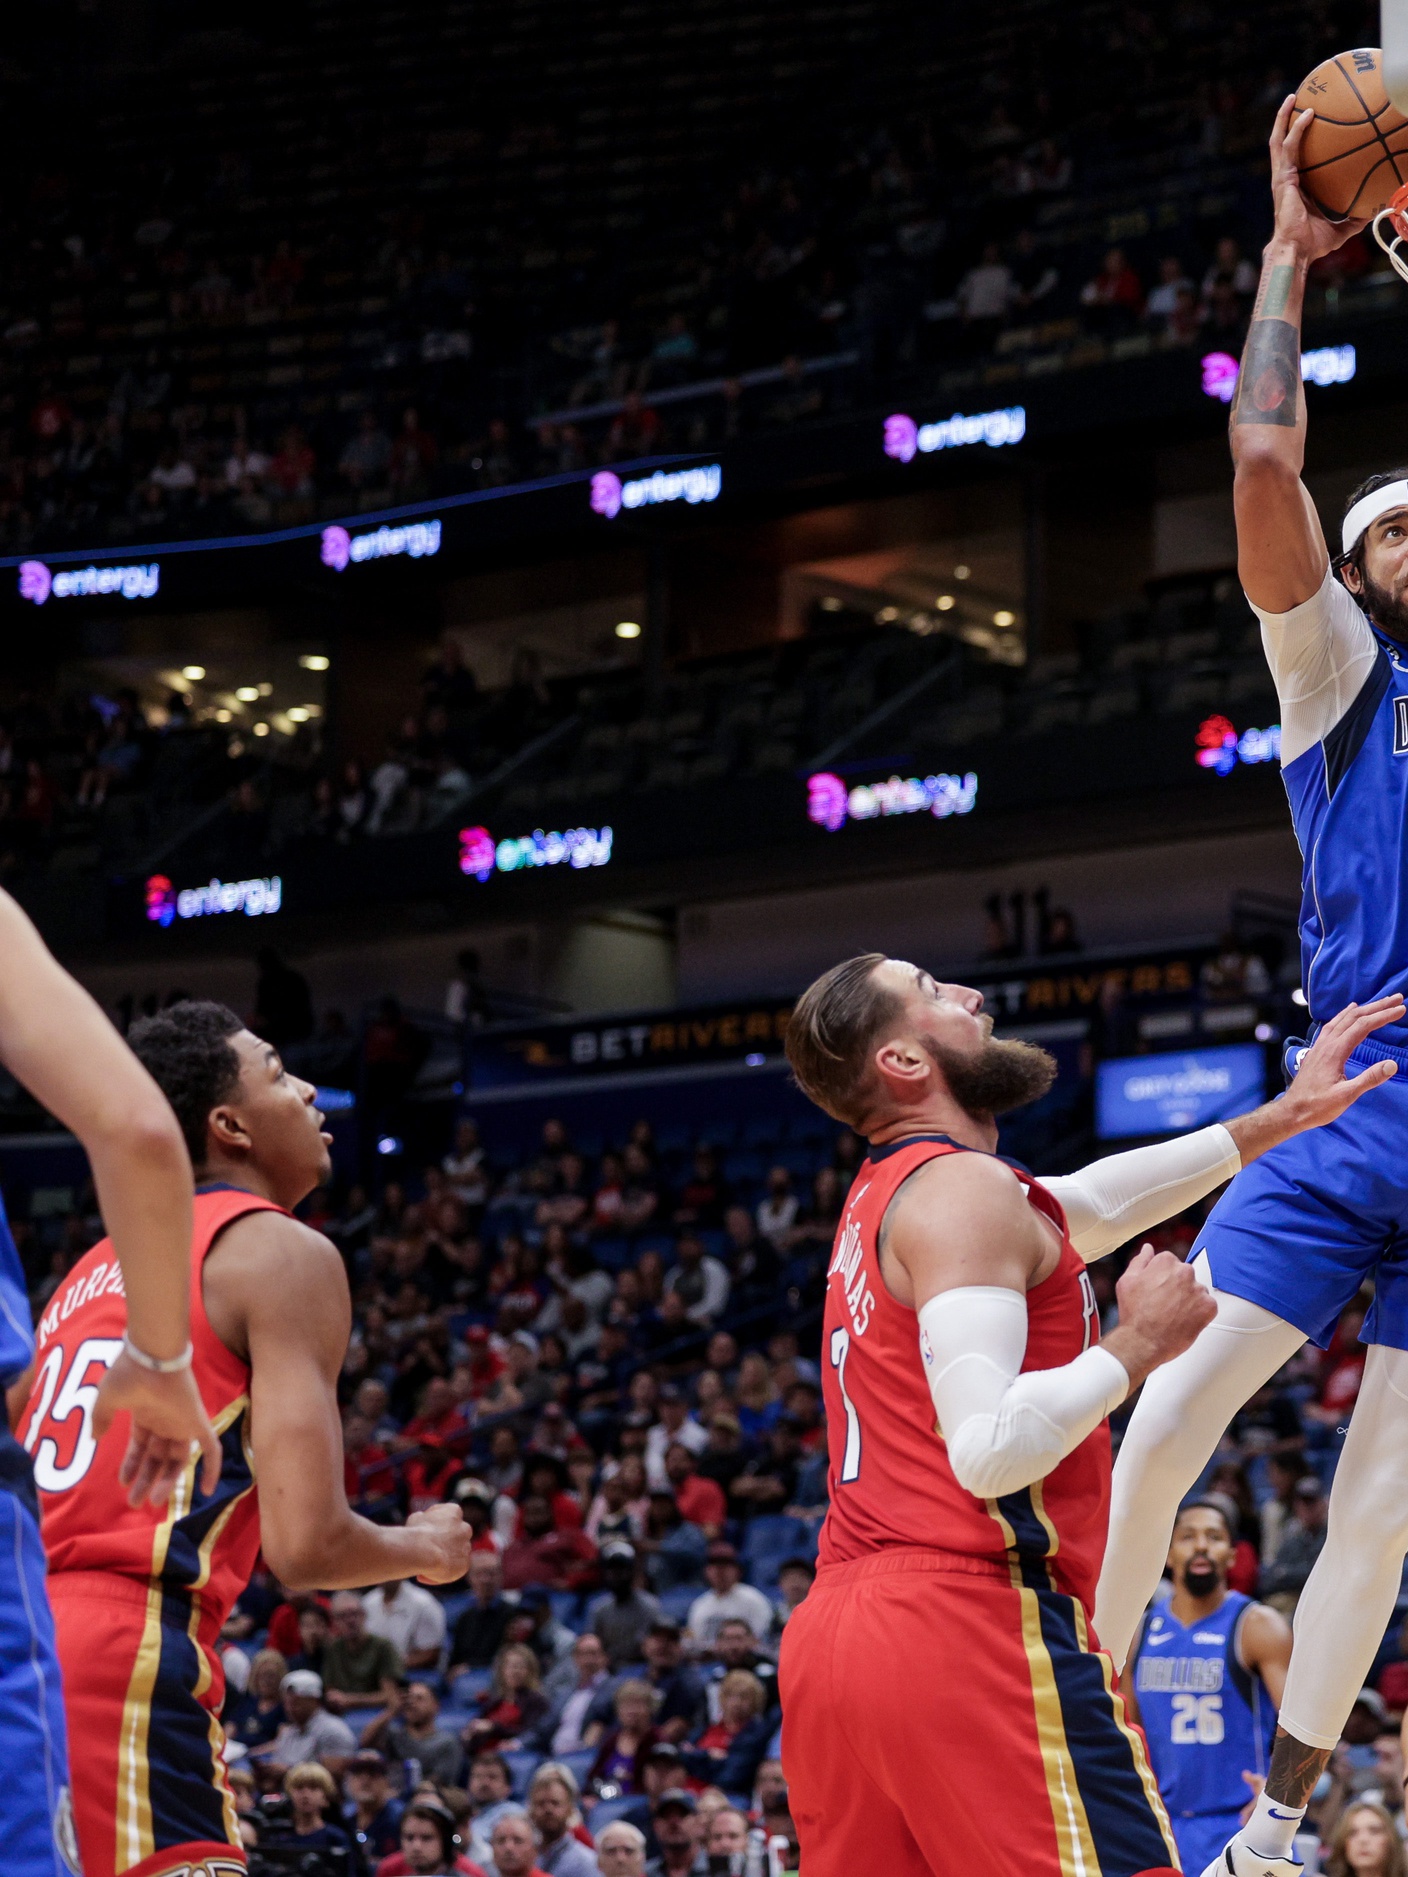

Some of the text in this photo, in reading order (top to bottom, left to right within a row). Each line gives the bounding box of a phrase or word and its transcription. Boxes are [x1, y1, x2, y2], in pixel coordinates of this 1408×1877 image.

[917, 406, 1026, 453] entergy
[621, 464, 722, 508] entergy
[349, 519, 442, 562] entergy
[52, 562, 160, 599] entergy
[176, 876, 282, 918] entergy
[829, 1325, 862, 1485] 7
[1170, 1693, 1225, 1746] 26
